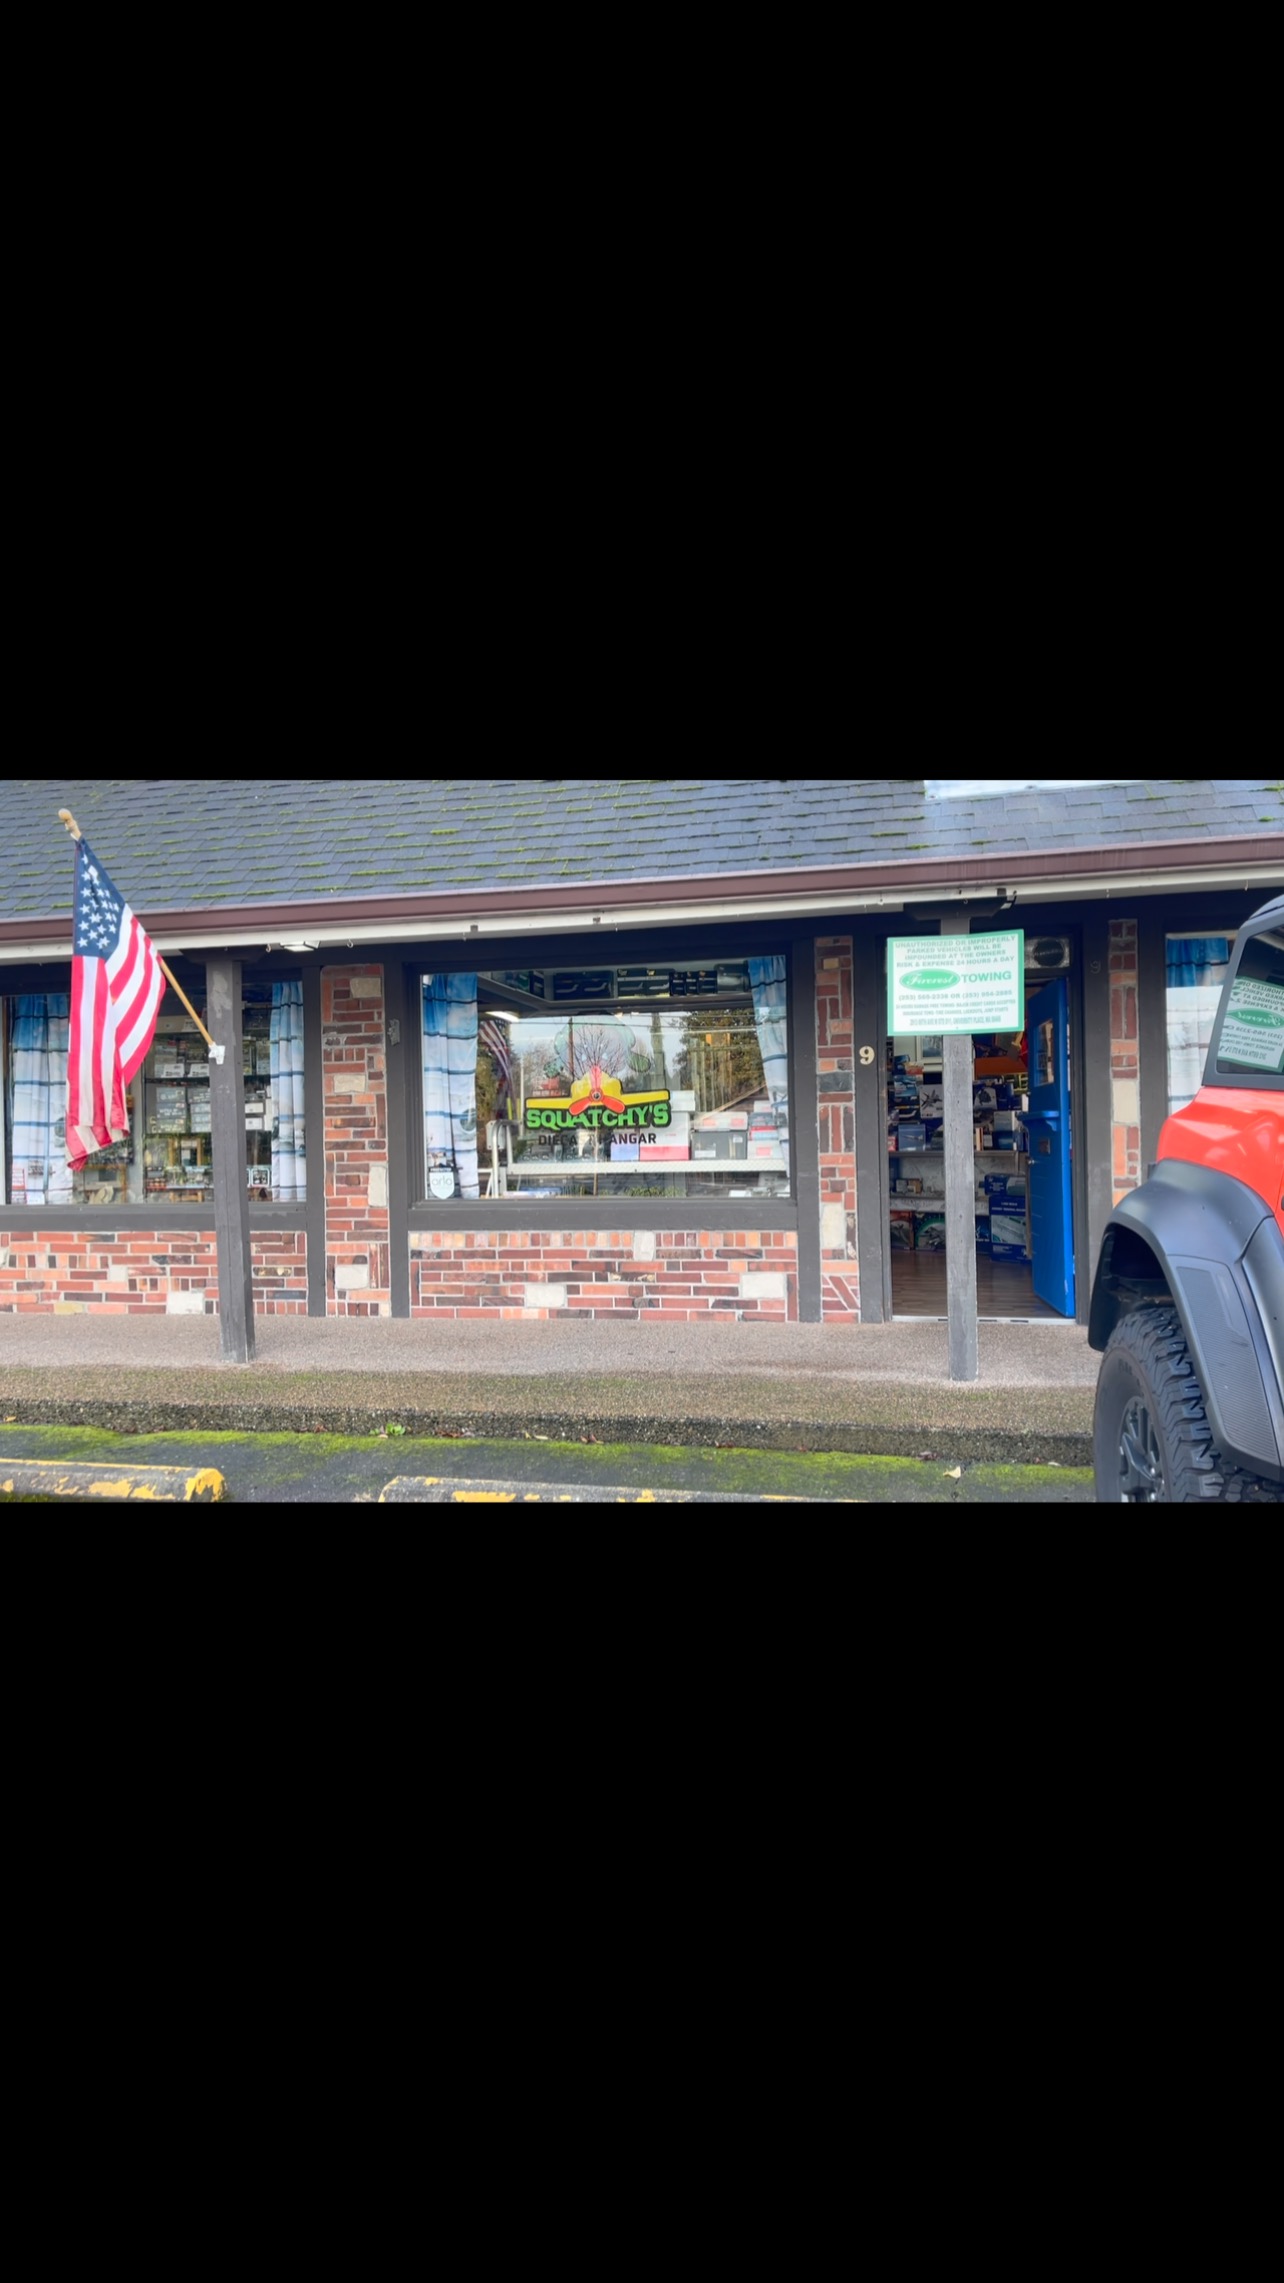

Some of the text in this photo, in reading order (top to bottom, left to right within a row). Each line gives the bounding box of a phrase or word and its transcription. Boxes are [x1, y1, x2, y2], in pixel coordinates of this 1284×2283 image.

[895, 939, 954, 948] UNAUTHORIZED
[967, 935, 1016, 945] IMPROPERLY
[937, 945, 971, 953] VEHICLES
[975, 949, 1006, 957] OWNERS
[1090, 960, 1101, 974] 9
[961, 970, 1012, 983] TOWING
[859, 1045, 875, 1065] 9
[526, 1102, 670, 1131] SQUATCHY'S
